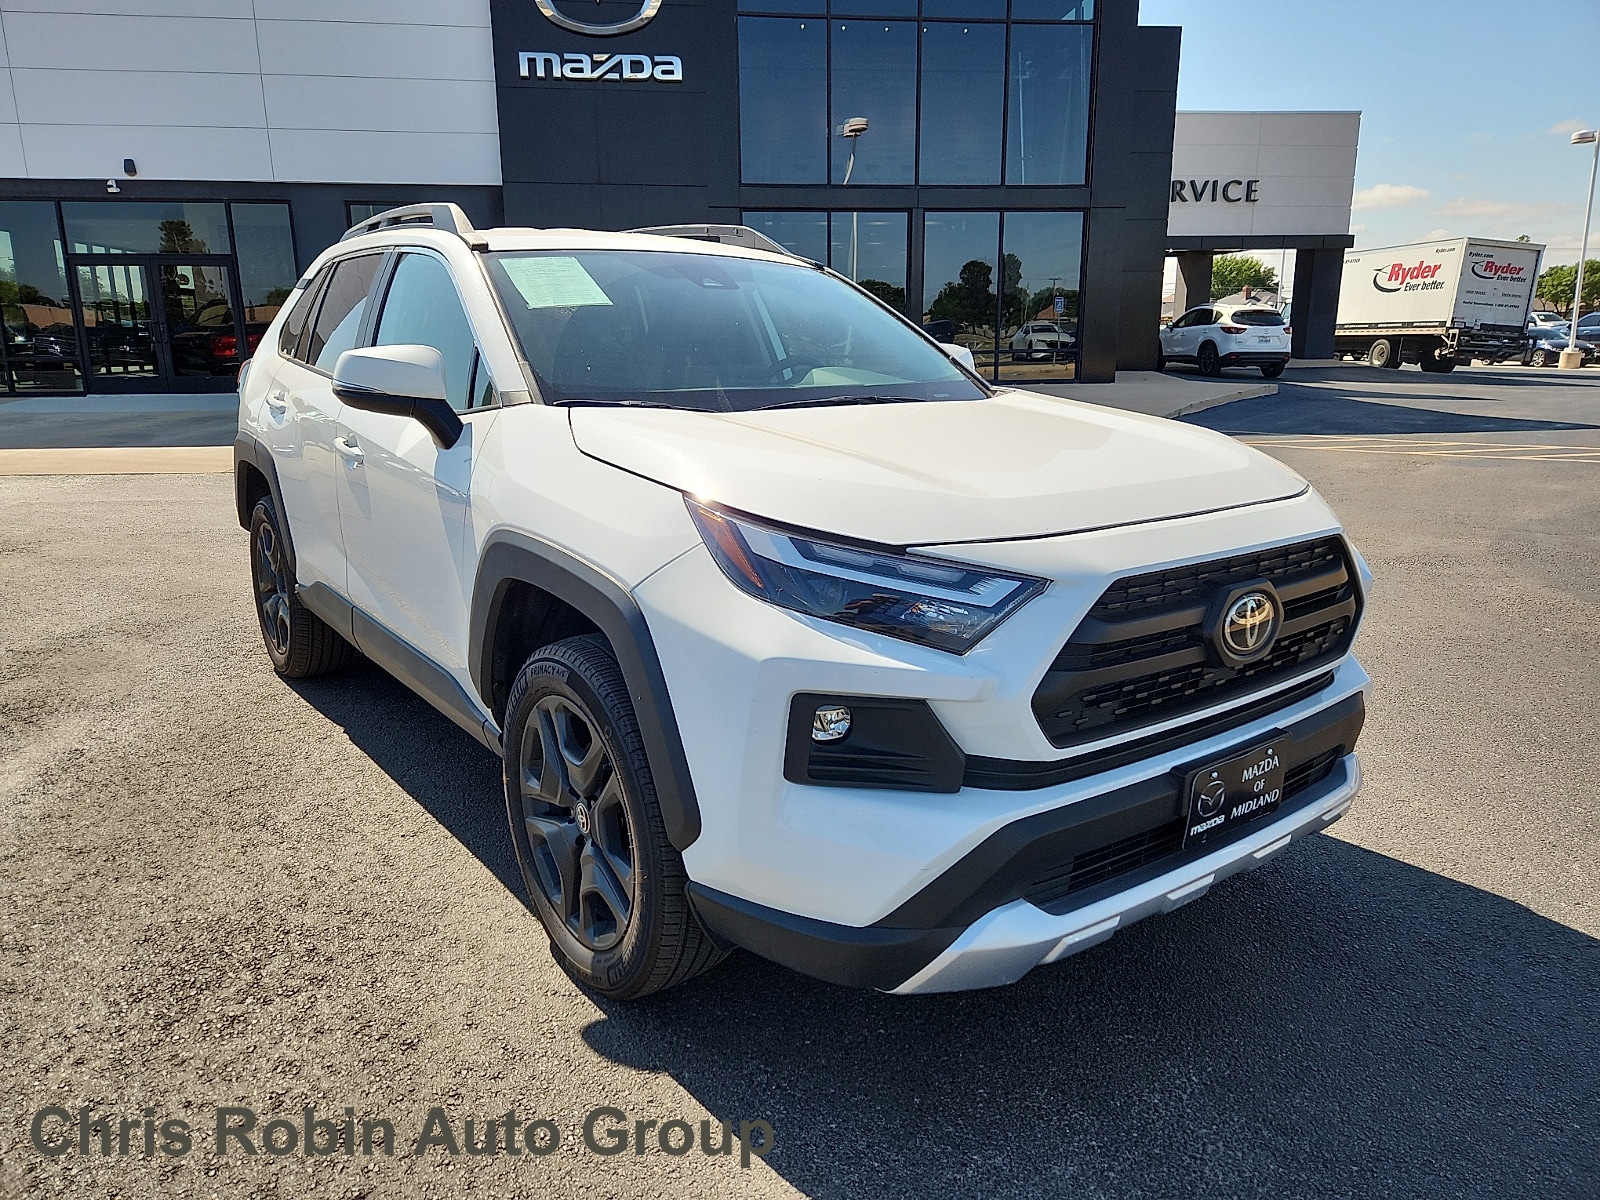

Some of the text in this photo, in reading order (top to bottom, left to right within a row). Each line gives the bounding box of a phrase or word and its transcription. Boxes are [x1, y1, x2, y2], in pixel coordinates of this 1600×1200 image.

[518, 51, 683, 83] mazda
[1468, 251, 1494, 259] Ryder.com
[1387, 260, 1442, 286] Ryder
[1483, 260, 1524, 276] Ryder
[1403, 281, 1421, 292] Ever
[530, 664, 555, 678] PRIMACY
[1241, 755, 1280, 782] MAZDA
[1253, 779, 1266, 792] OF
[1230, 788, 1280, 819] MIDLAND
